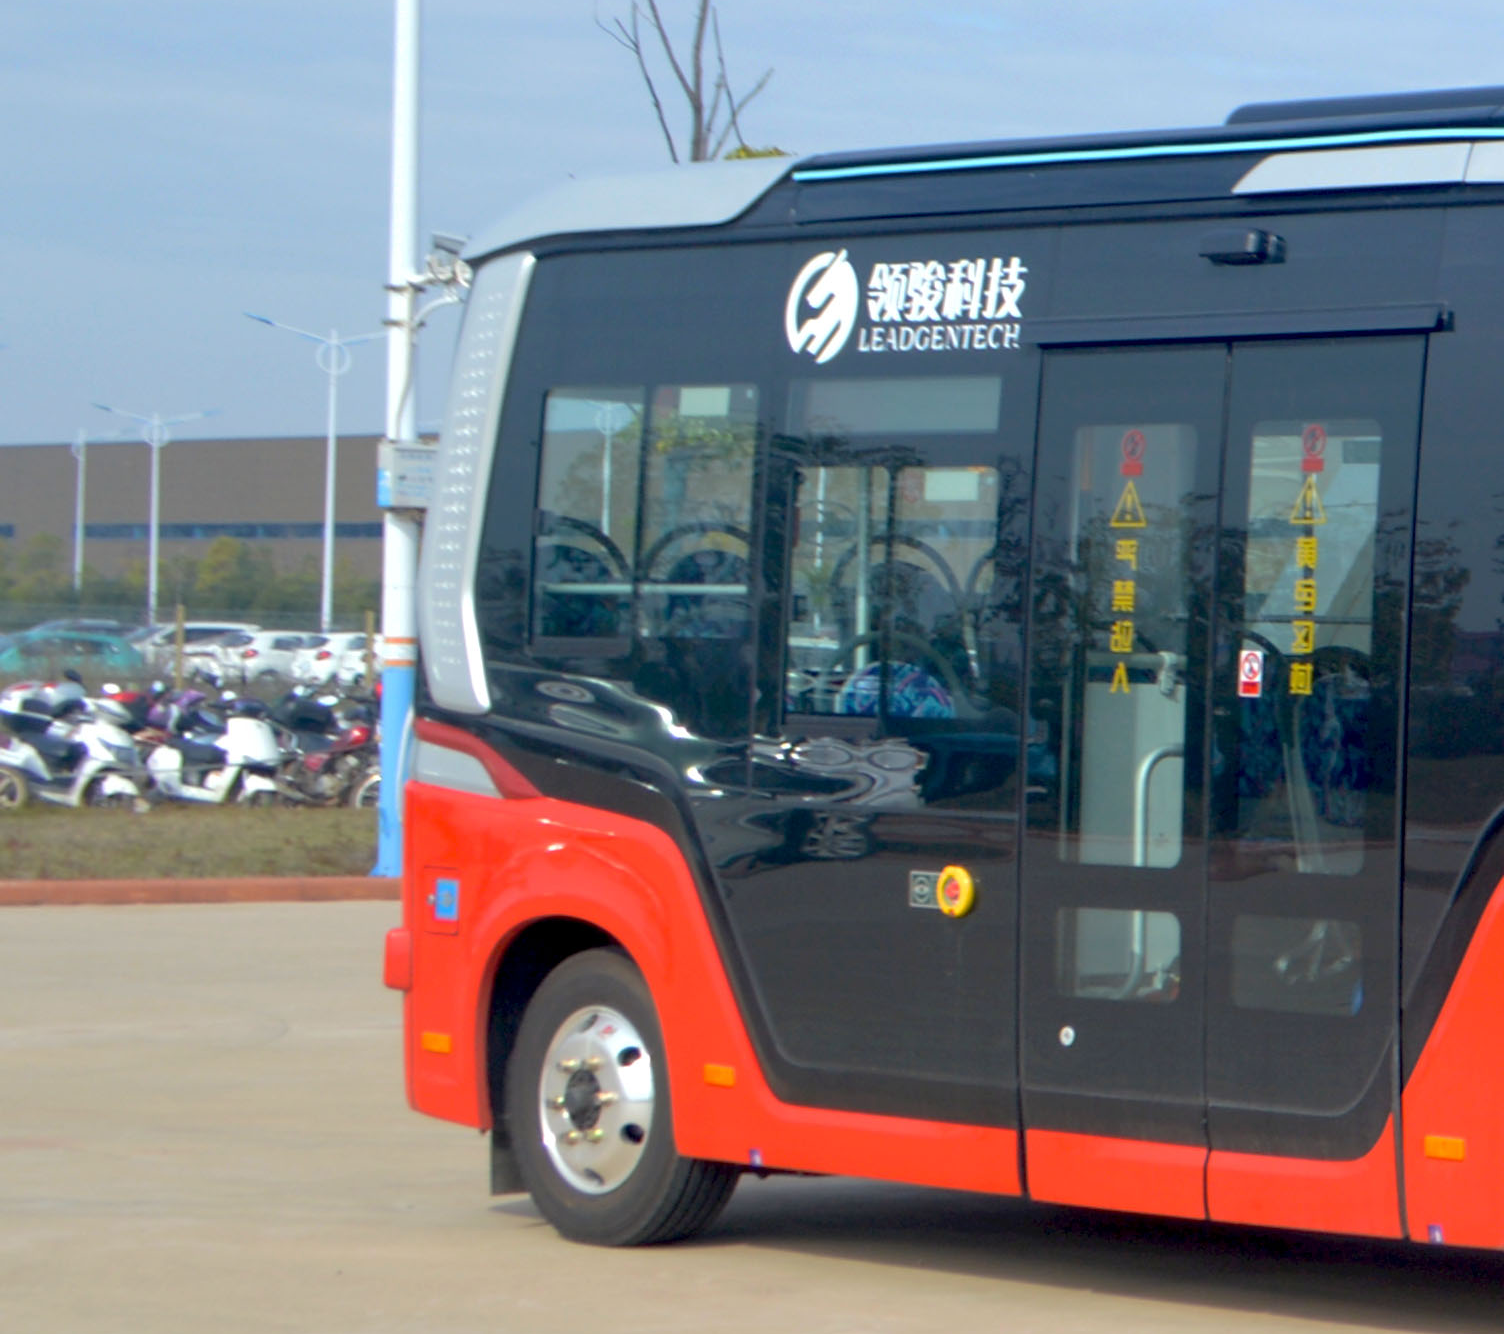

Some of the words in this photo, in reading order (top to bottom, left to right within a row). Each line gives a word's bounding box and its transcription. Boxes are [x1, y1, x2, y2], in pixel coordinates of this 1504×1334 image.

[866, 256, 1029, 322] 领骏科技
[857, 323, 1022, 352] LEADGENTECH
